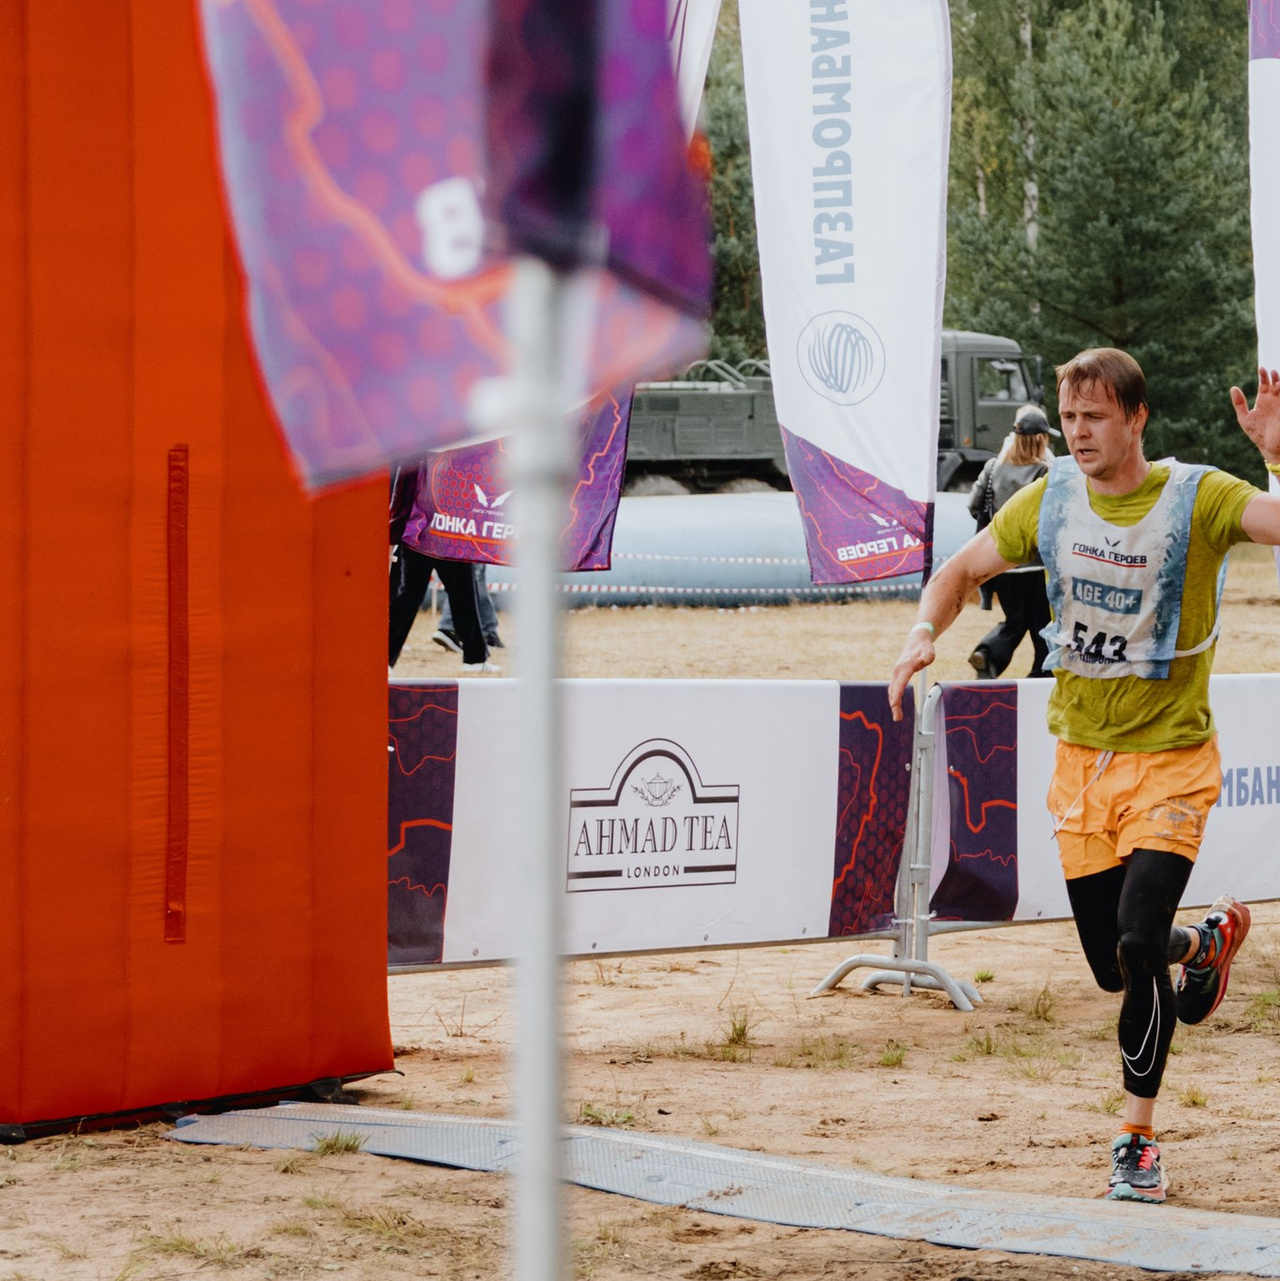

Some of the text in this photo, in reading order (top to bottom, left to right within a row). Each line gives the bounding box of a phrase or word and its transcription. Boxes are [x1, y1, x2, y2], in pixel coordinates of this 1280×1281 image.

[430, 512, 477, 535] ГОНКА
[1072, 542, 1147, 564] ГОНКА ГЕРОЕВ
[1076, 583, 1137, 610] AGE 40+
[1066, 620, 1128, 661] 543
[573, 814, 733, 857] AHMAD TEA
[625, 865, 681, 879] LONDON
